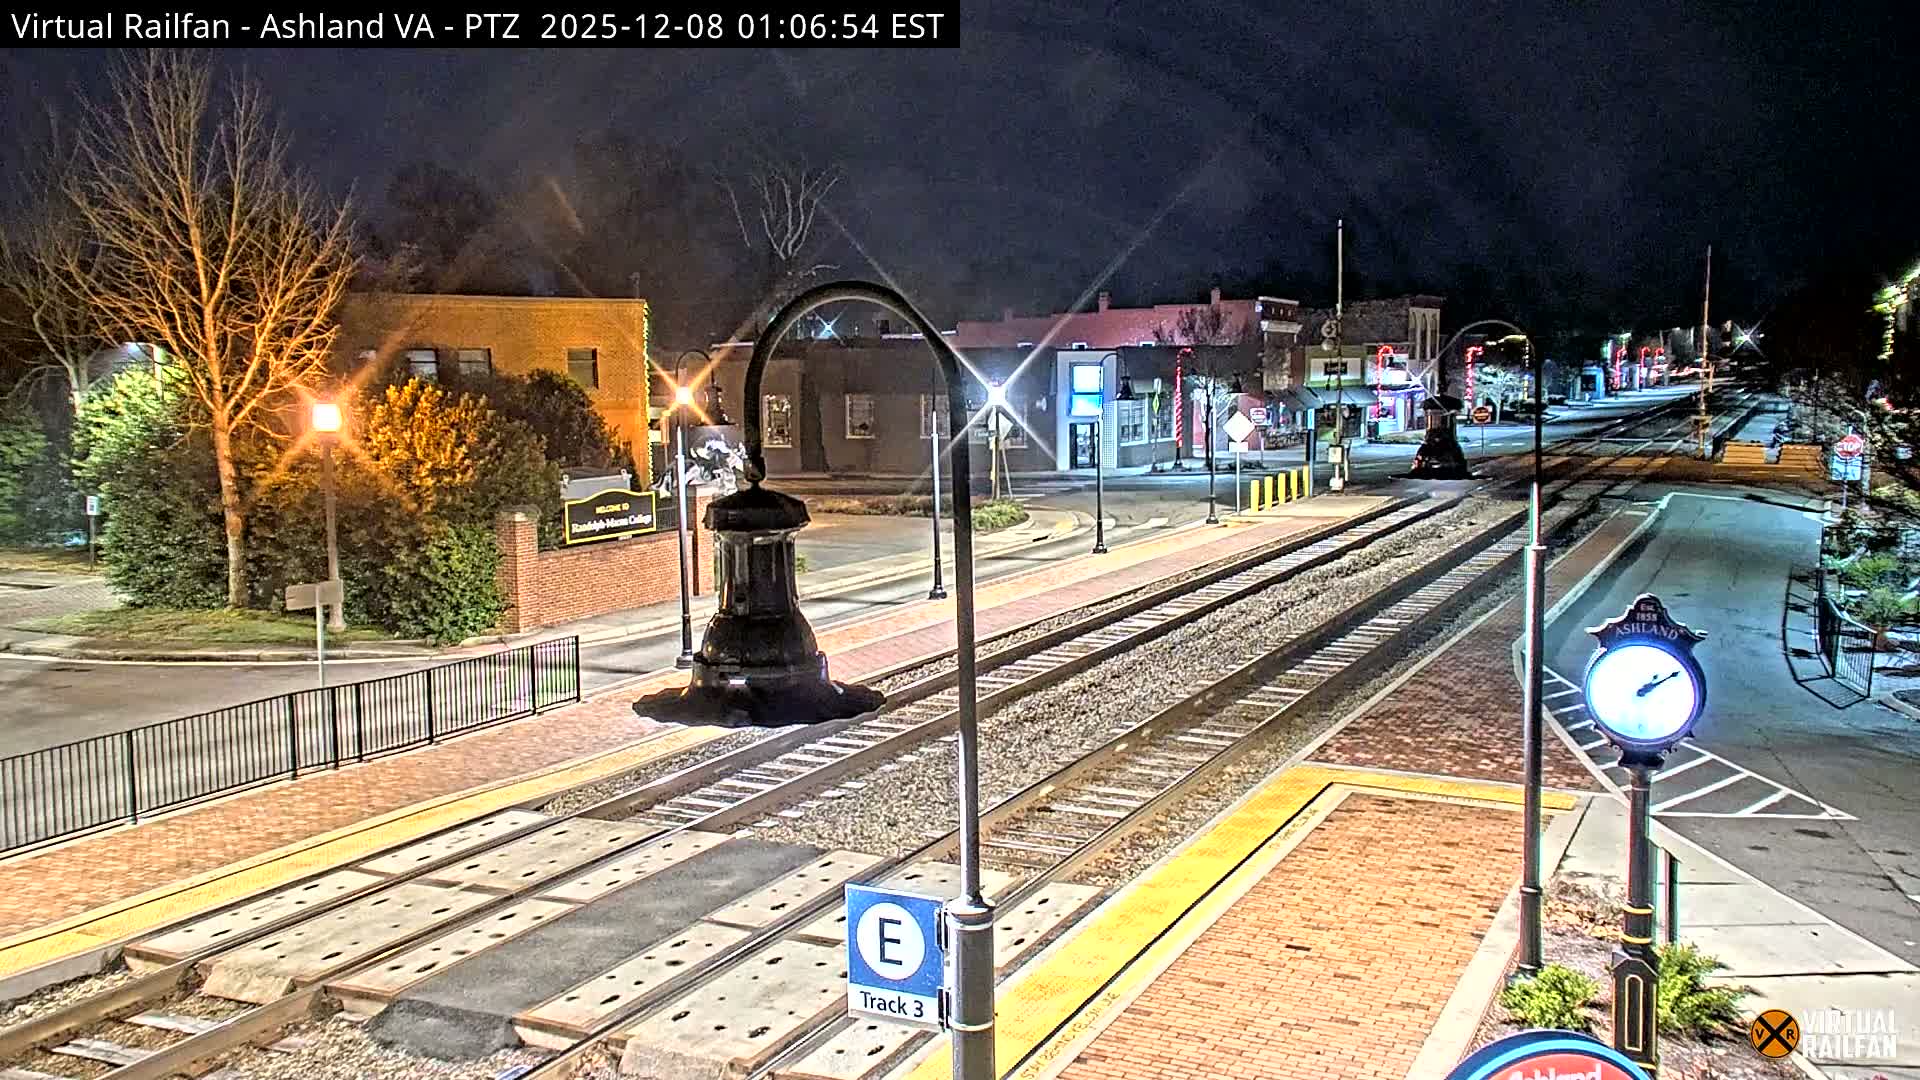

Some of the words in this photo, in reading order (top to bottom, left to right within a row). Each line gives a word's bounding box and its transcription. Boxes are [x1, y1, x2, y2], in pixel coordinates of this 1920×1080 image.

[1615, 622, 1678, 640] ASHLAND
[878, 916, 903, 966] E
[859, 990, 908, 1016] Track
[913, 999, 925, 1018] 3
